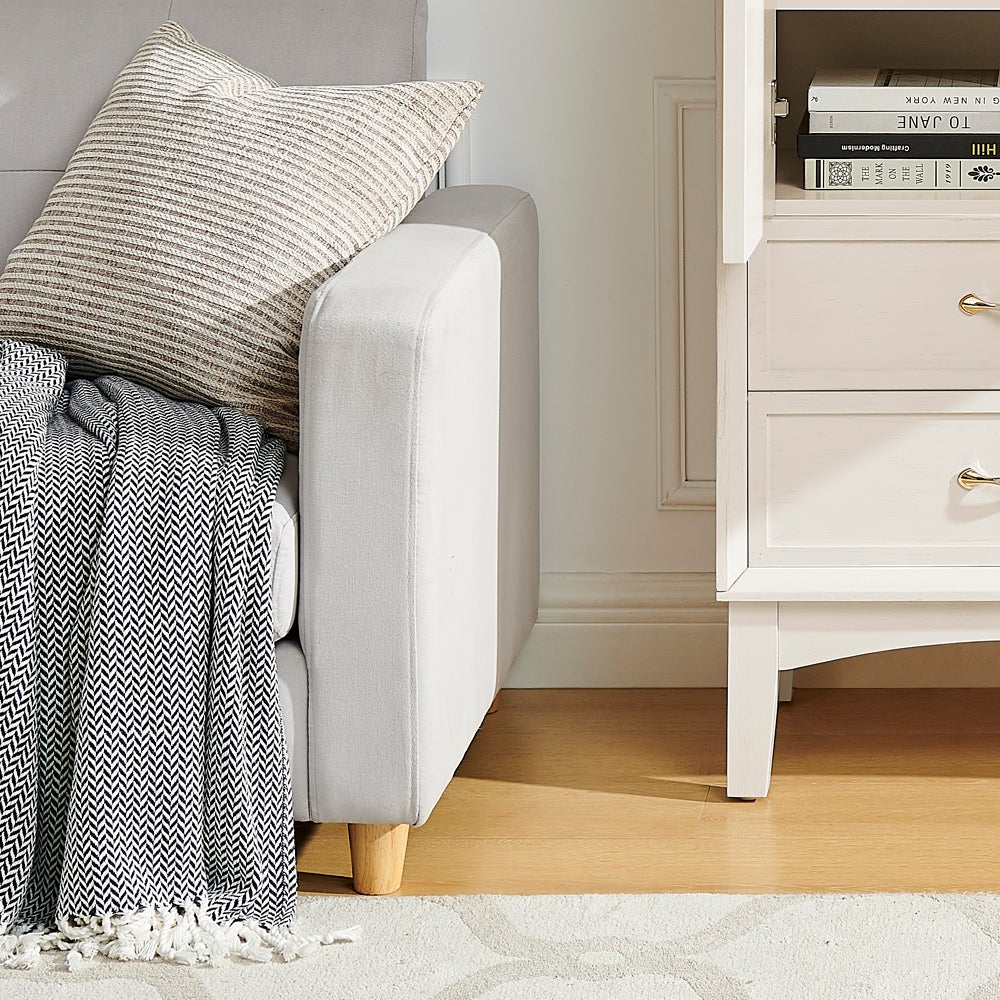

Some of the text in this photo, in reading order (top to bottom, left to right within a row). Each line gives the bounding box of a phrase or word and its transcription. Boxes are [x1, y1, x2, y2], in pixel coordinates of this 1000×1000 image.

[906, 96, 935, 104] YORK
[943, 96, 967, 105] NEW
[975, 97, 985, 105] IN
[897, 116, 970, 128] TO JANE
[842, 144, 909, 152] Crafting Modernism
[973, 144, 996, 155] Hill
[861, 167, 870, 181] THE
[874, 163, 884, 184] MARK
[888, 169, 897, 179] ON
[901, 167, 911, 181] THE
[915, 164, 924, 184] WALL
